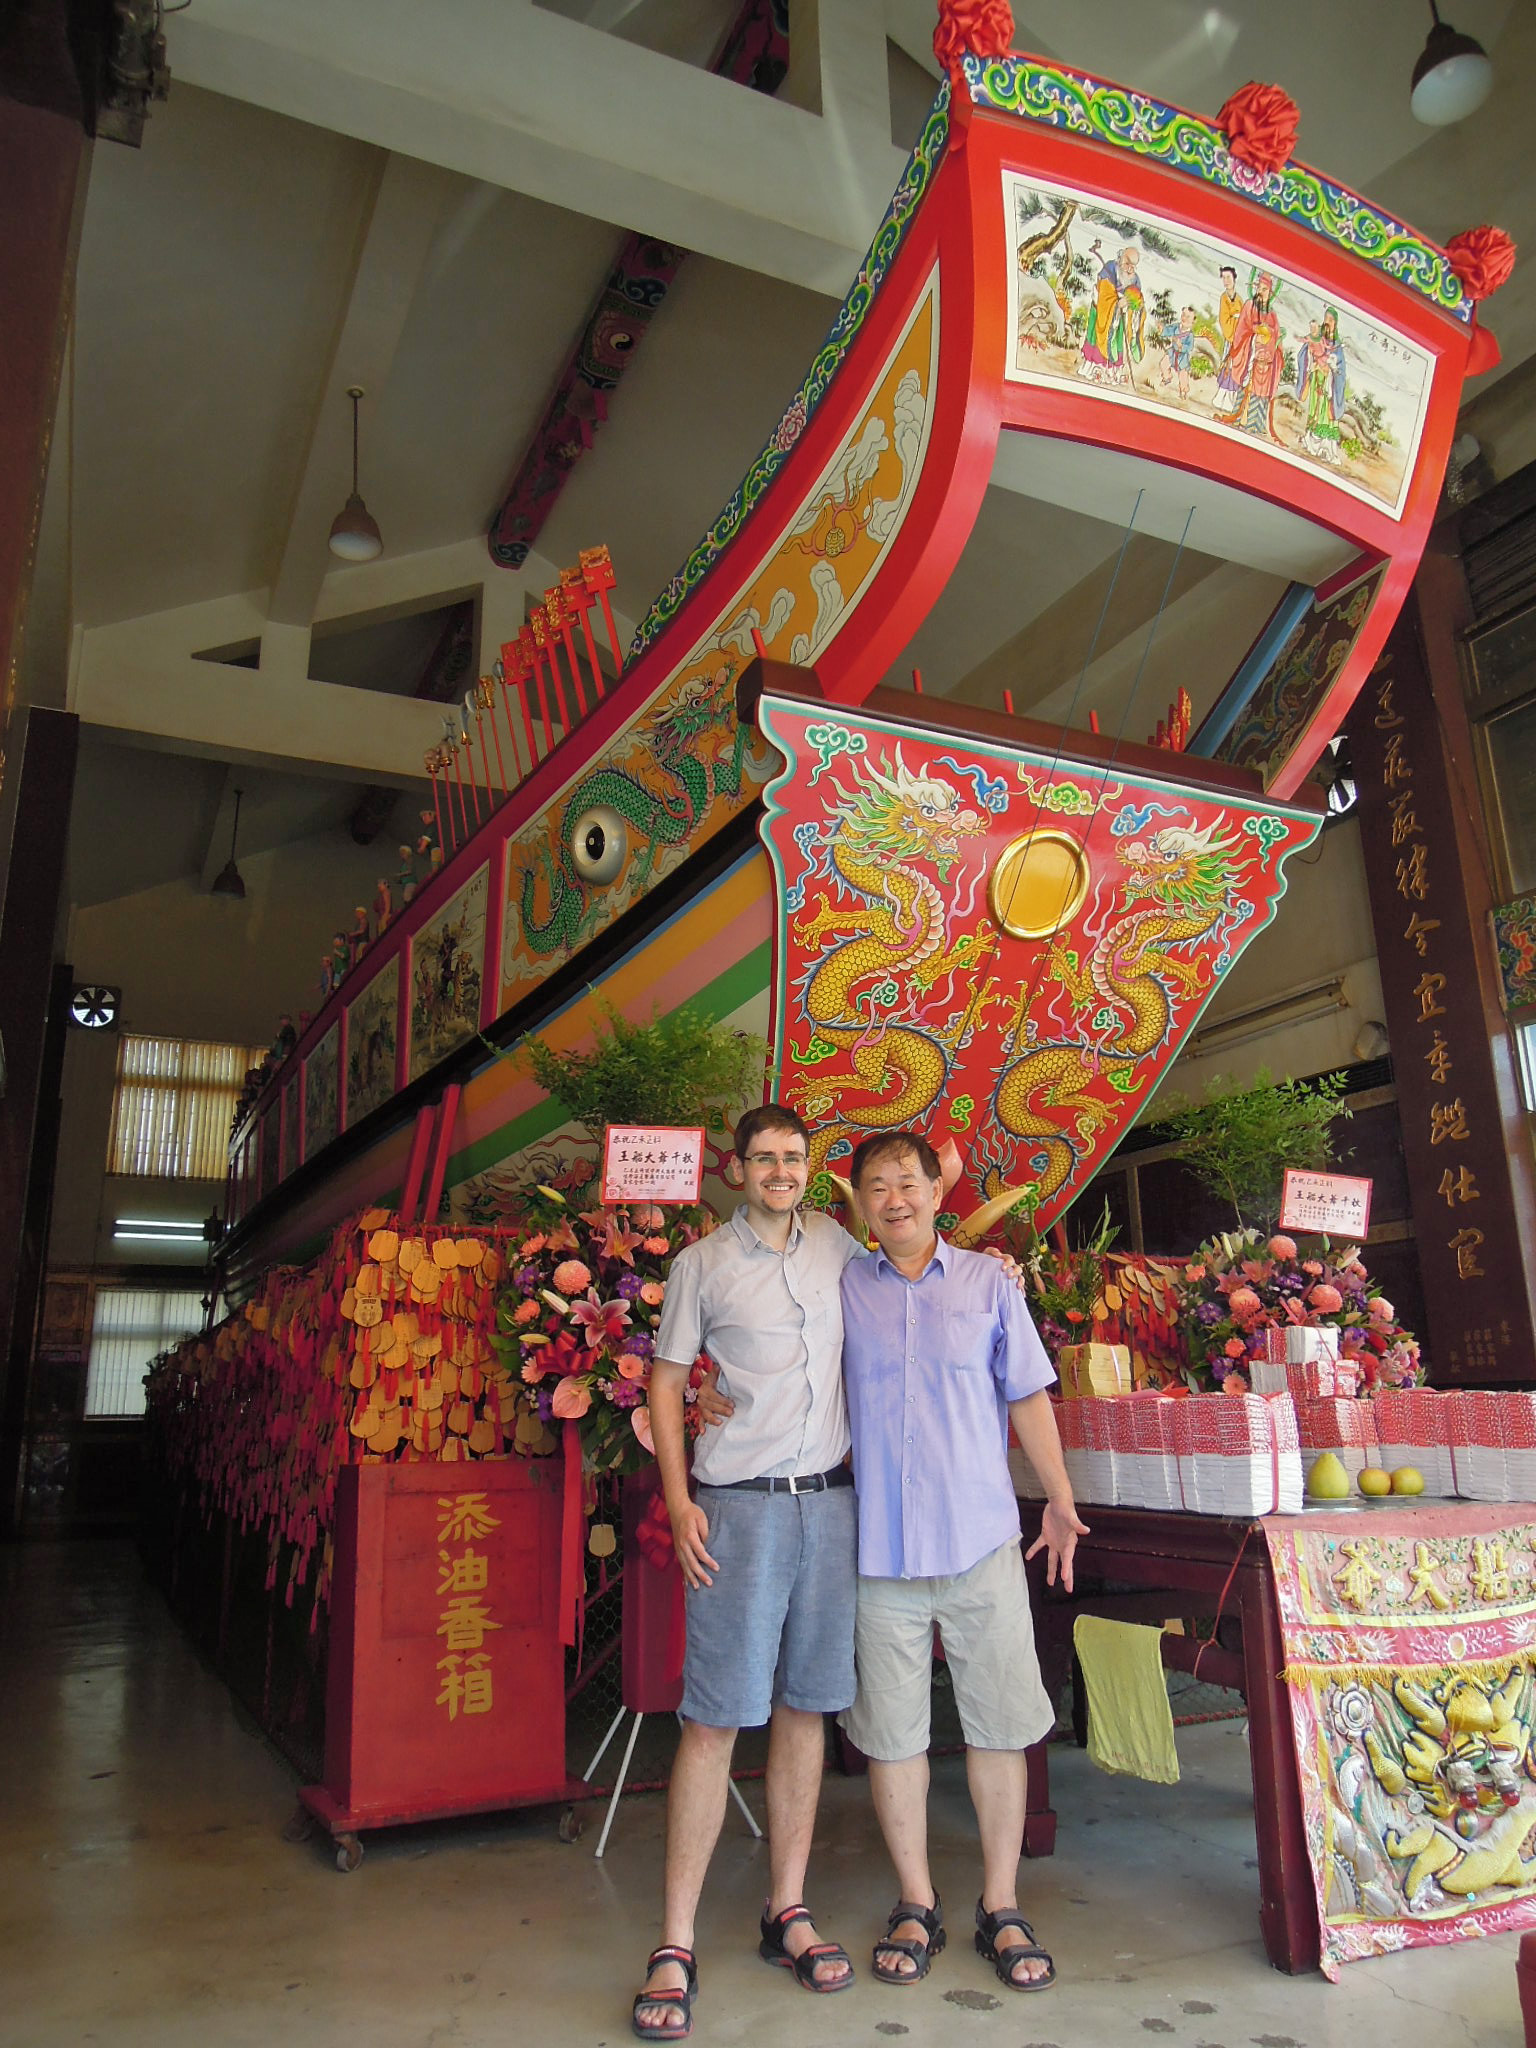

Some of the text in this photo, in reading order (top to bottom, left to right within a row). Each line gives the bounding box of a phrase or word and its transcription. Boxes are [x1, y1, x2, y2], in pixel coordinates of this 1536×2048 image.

[618, 1150, 694, 1165] 王船大爺千秋
[435, 1493, 503, 1721] 添油香箱
